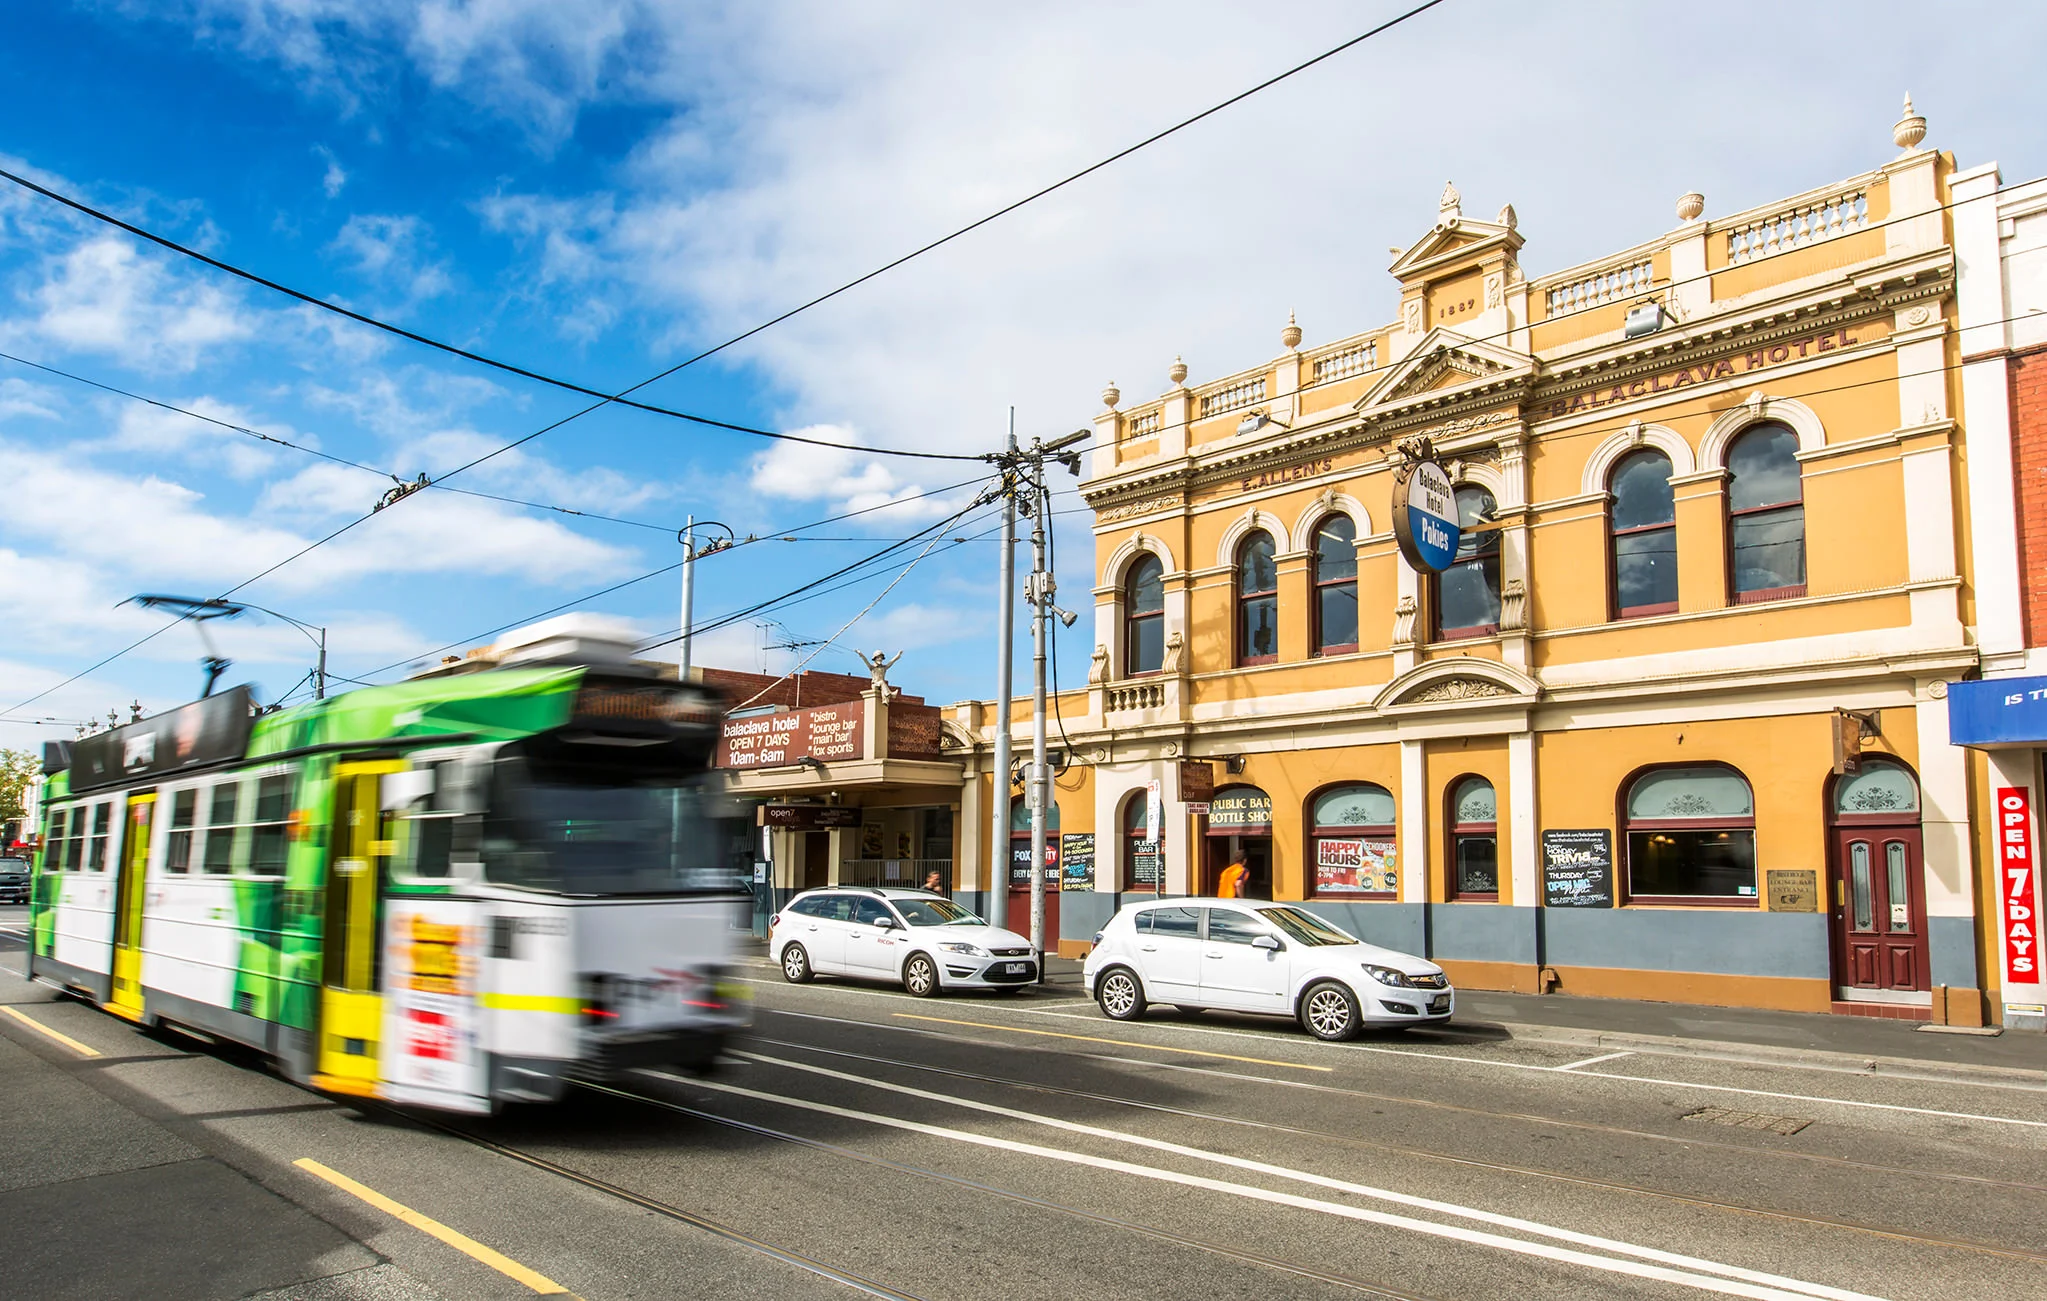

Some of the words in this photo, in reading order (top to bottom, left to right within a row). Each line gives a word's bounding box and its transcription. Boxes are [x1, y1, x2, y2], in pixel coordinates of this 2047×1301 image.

[1440, 299, 1475, 318] 1887
[1551, 359, 1734, 418] BALACLAVA
[1745, 328, 1858, 370] HOTEL
[1419, 467, 1450, 500] Balaclava
[1426, 491, 1444, 516] Hotel
[1422, 516, 1449, 552] Pokies
[2004, 693, 2024, 706] IS
[814, 711, 837, 723] bistro
[723, 720, 770, 738] balaclava
[772, 714, 800, 732] hotel
[813, 722, 841, 735] lounge
[842, 719, 857, 730] bar
[729, 736, 754, 751] OPEN
[756, 735, 764, 748] 7
[765, 732, 790, 747] DAYS
[813, 732, 833, 745] main
[835, 731, 850, 743] bar
[813, 745, 826, 757] fox
[827, 742, 854, 757] sports
[1213, 798, 1248, 810] PUBLIC
[1249, 797, 1271, 808] BAR
[1208, 811, 1246, 824] BOTTLE
[2002, 796, 2026, 860] OPEN
[1320, 842, 1361, 855] HAPPY
[1013, 850, 1032, 862] FOX
[1320, 853, 1361, 866] HOURS
[1013, 869, 1026, 879] EVERY
[1049, 869, 1060, 879] HERE
[1547, 880, 1572, 891] OPEN
